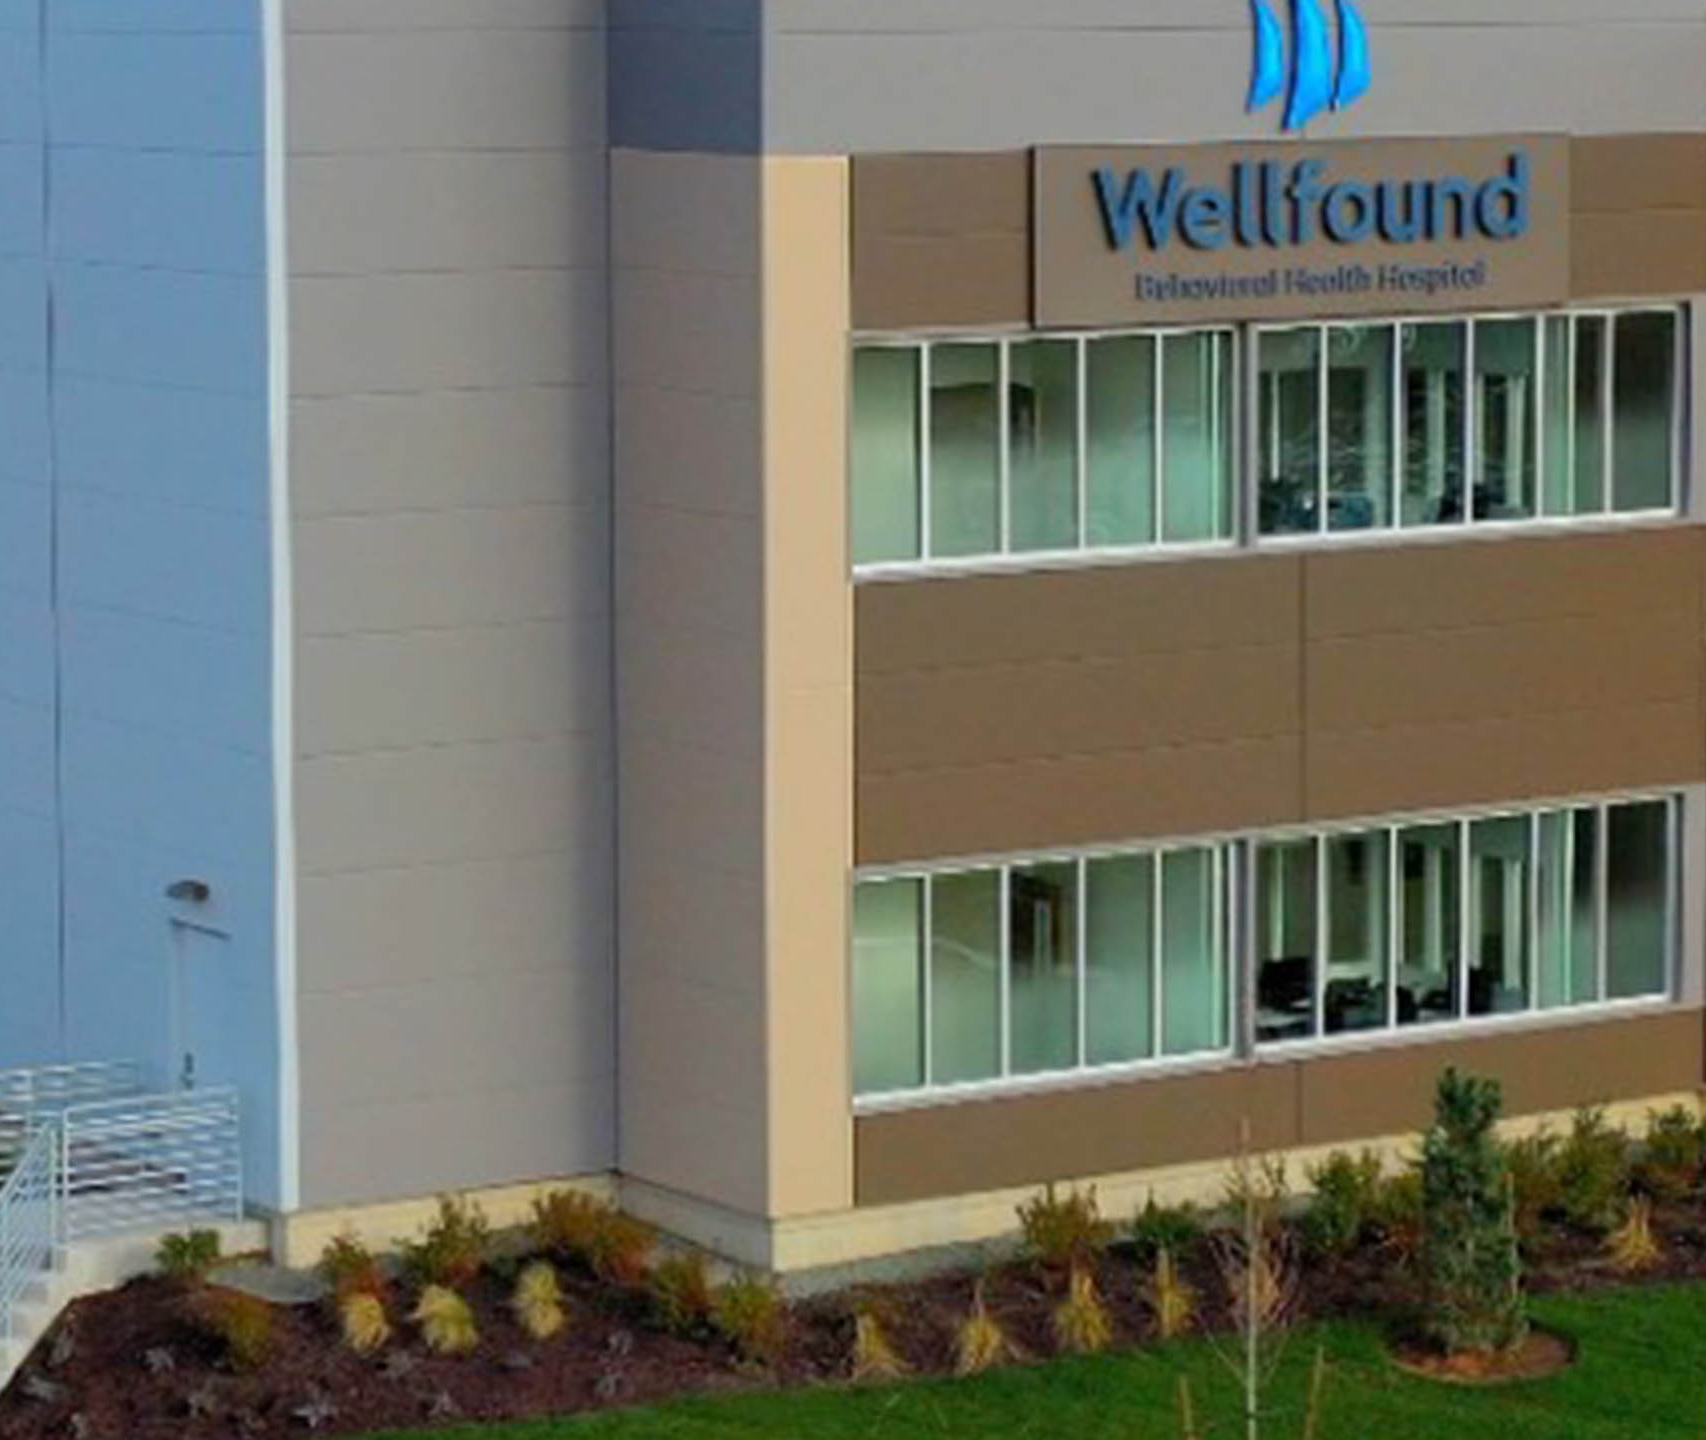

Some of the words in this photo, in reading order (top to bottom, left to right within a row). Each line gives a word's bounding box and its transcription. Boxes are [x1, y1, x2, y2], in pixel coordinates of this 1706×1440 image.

[1090, 152, 1531, 252] Wellfound
[1134, 269, 1277, 300] Behavioral
[1284, 265, 1370, 295] Health
[1377, 260, 1485, 294] Hospital
